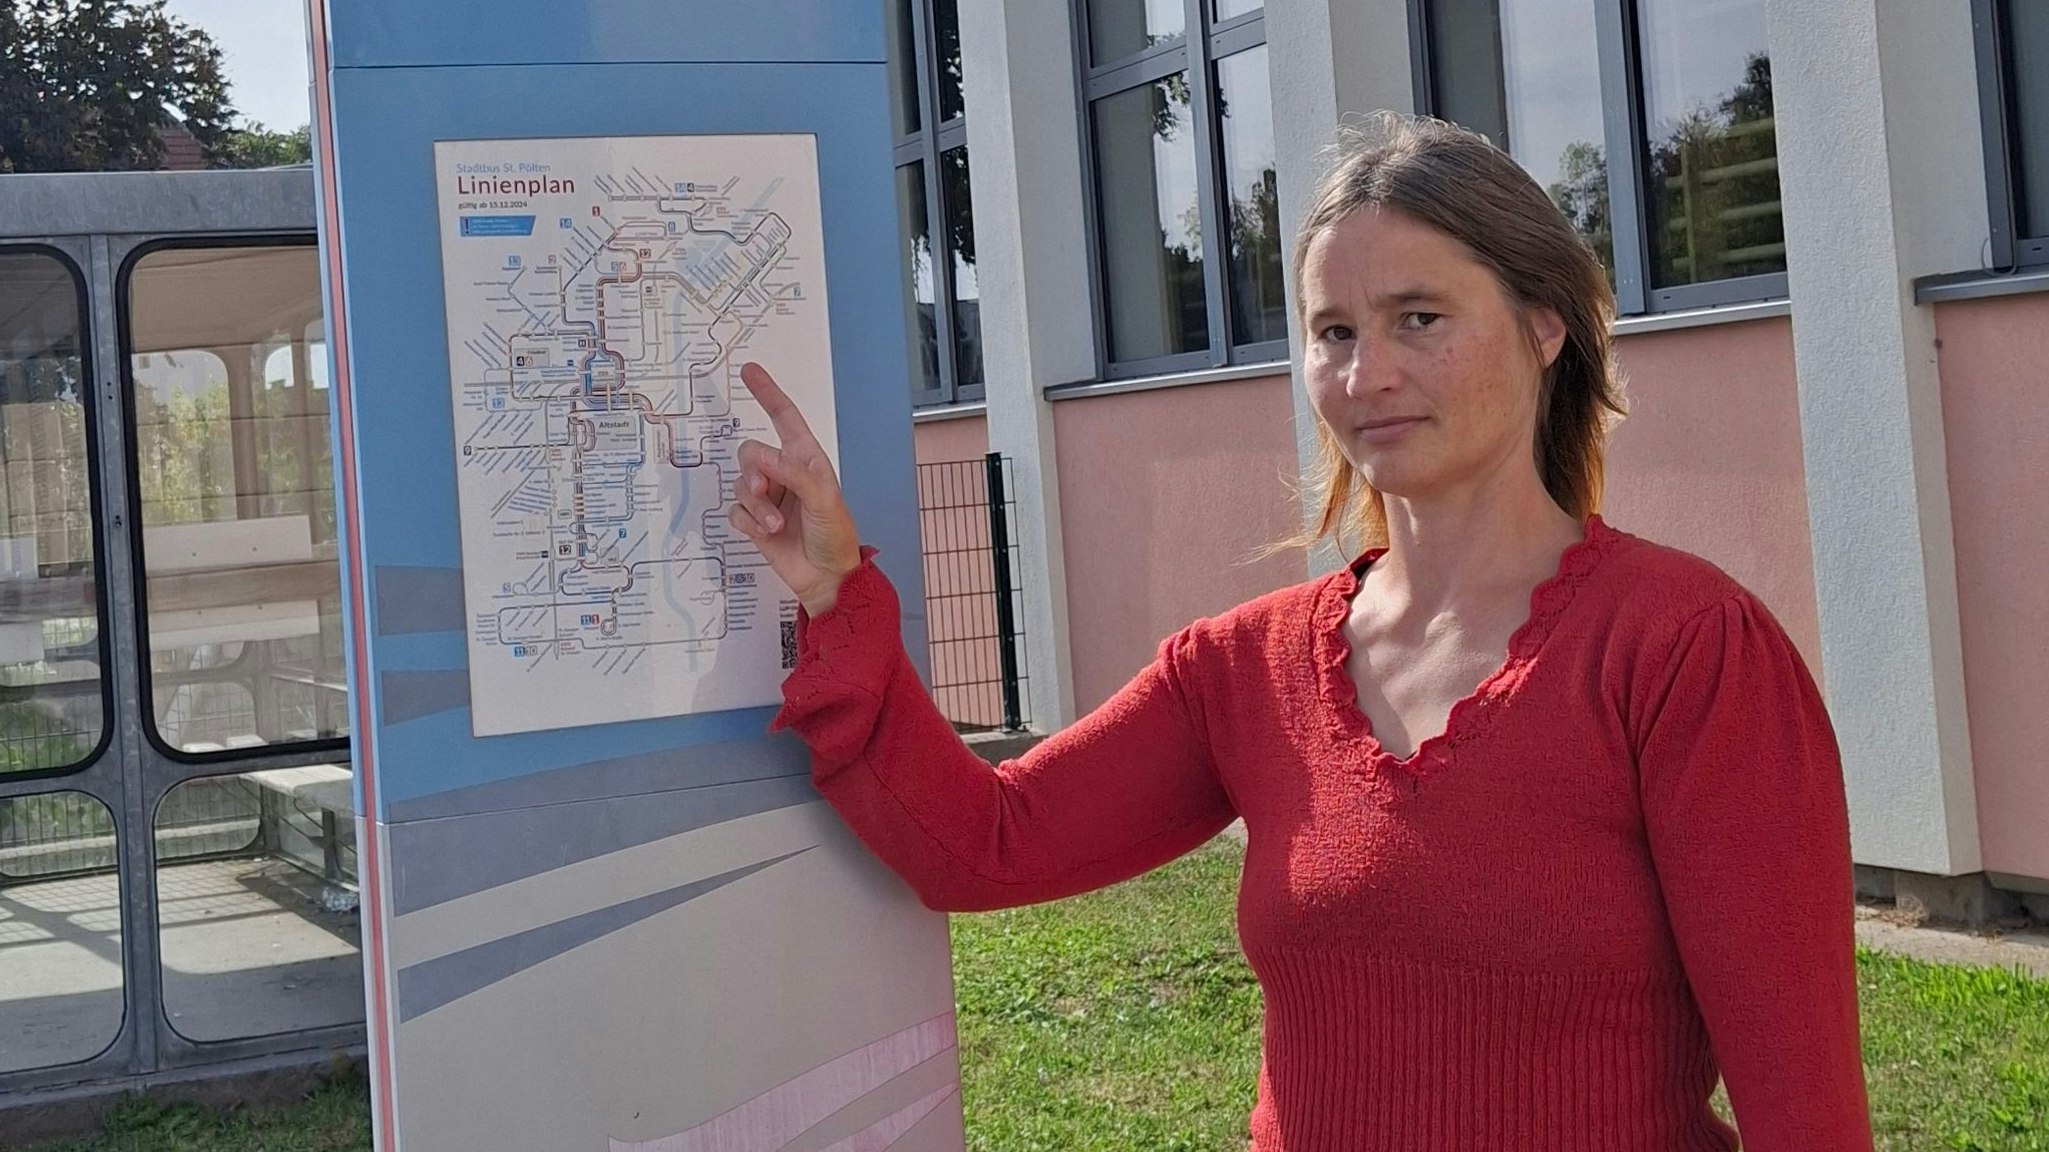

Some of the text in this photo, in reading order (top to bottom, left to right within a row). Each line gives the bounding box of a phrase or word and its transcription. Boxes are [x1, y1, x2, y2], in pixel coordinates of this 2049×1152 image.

[456, 162, 551, 173] Stadtbus St. Pölten
[458, 174, 575, 198] Linienplan
[458, 200, 528, 210] gültig ab 15.12.2024
[598, 421, 630, 429] Altstadt
[559, 545, 571, 555] 12
[581, 615, 591, 624] 11
